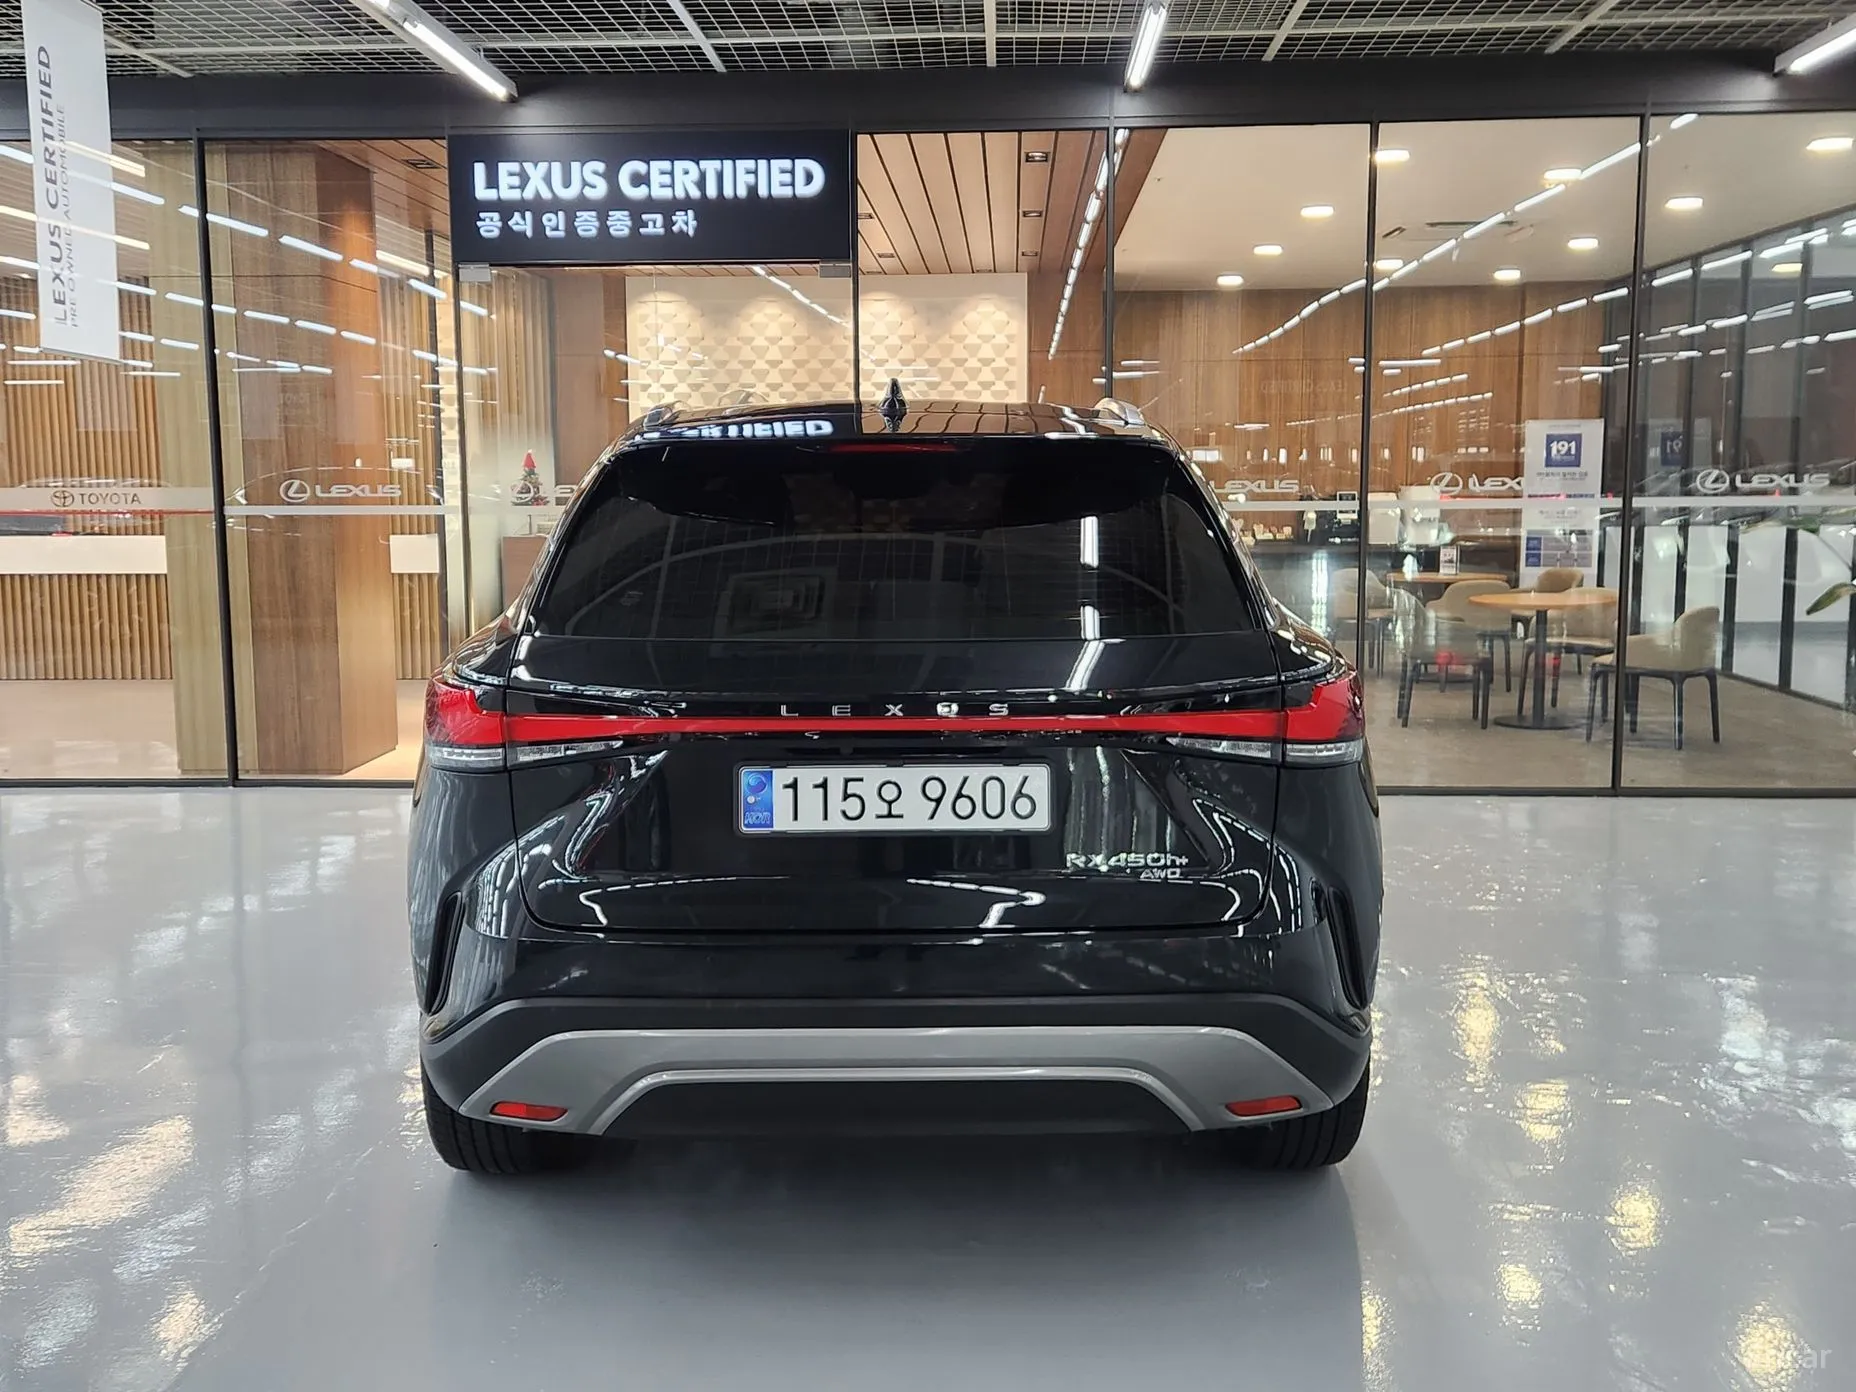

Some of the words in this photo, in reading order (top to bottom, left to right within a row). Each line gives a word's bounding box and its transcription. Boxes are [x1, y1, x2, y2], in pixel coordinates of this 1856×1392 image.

[37, 45, 59, 210] CERTIFIED
[473, 160, 609, 200] LEXUS
[617, 158, 826, 199] CERTIFIED
[48, 222, 68, 324] LEXUS
[1549, 440, 1576, 458] 191
[1209, 479, 1300, 493] LEXUS
[1468, 475, 1524, 492] LEX
[1735, 473, 1830, 488] LEXUS
[79, 493, 142, 506] TOYOTA
[315, 484, 402, 498] LEXUS
[782, 776, 904, 822] 115오
[921, 775, 1037, 821] 9606
[1140, 868, 1180, 879] AWD
